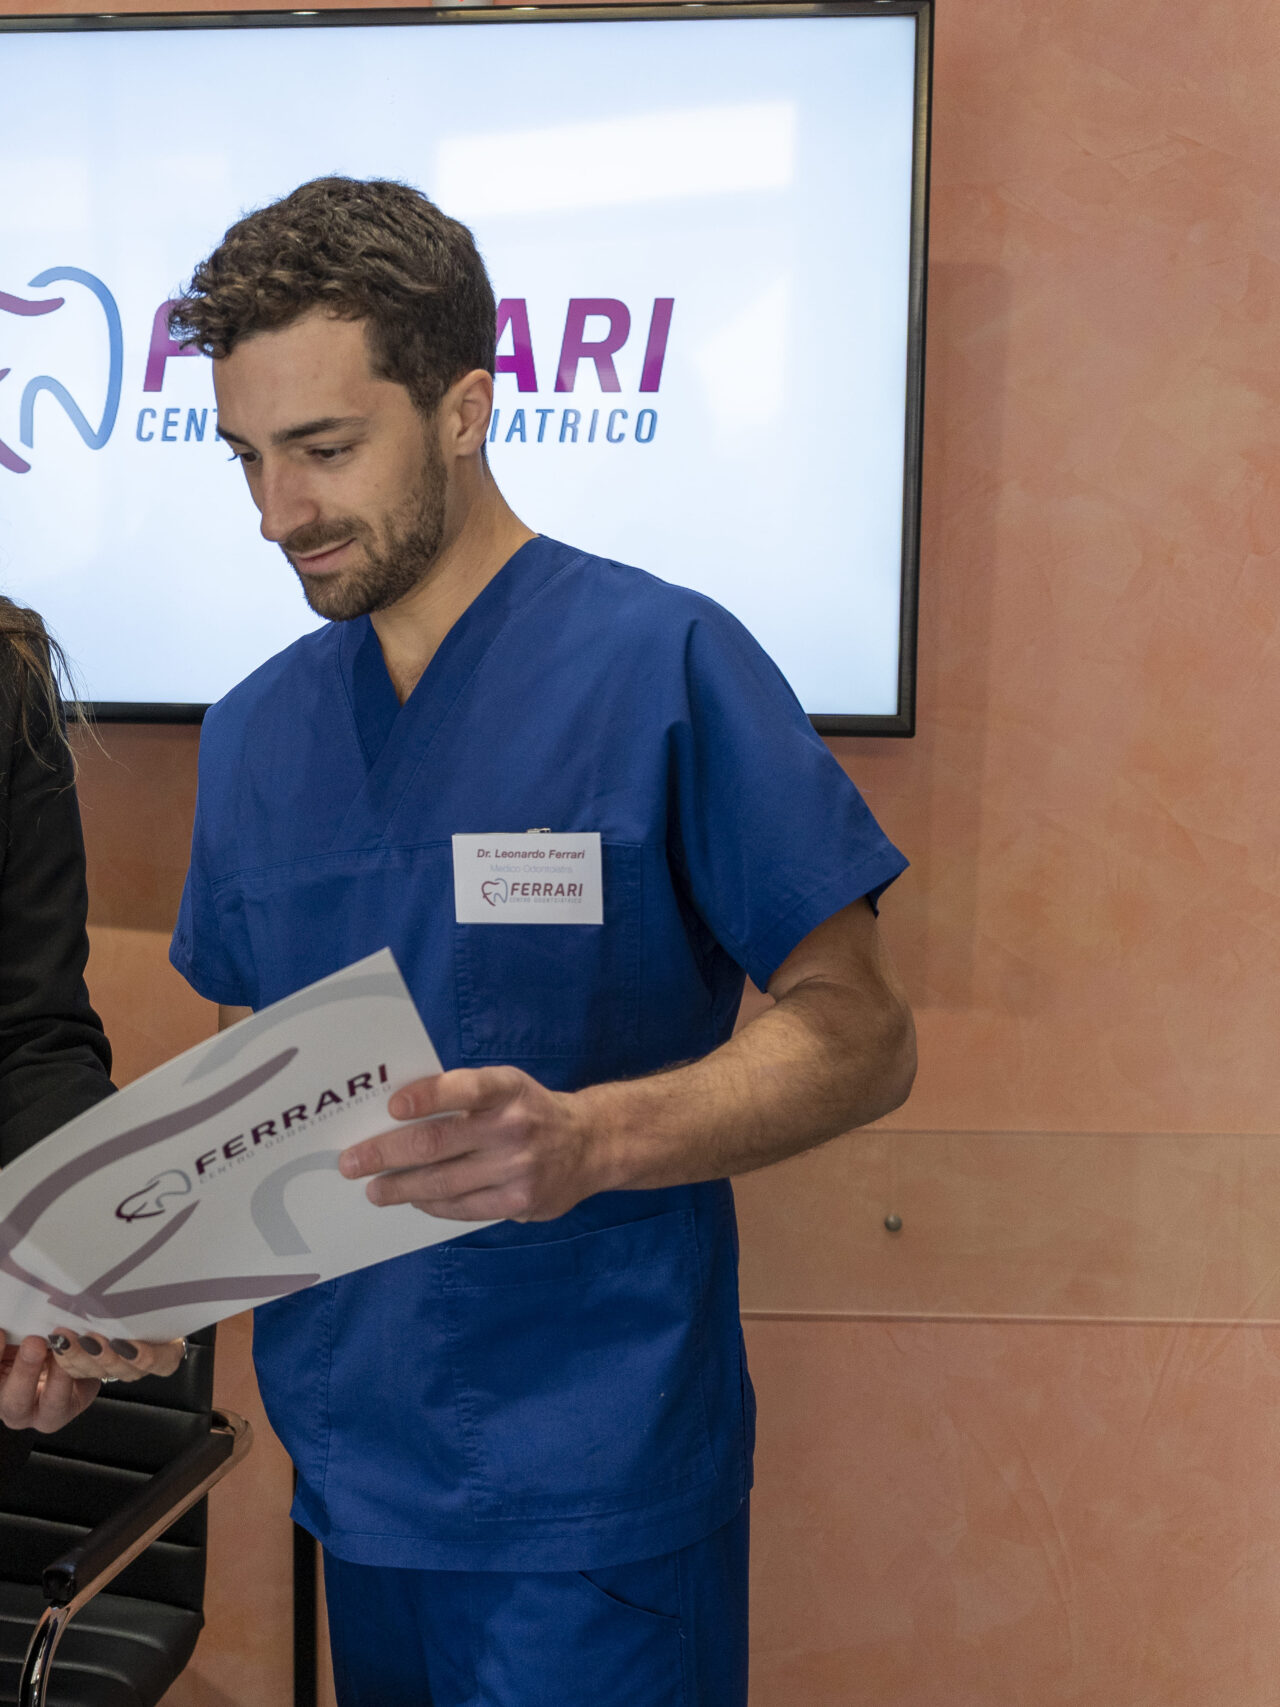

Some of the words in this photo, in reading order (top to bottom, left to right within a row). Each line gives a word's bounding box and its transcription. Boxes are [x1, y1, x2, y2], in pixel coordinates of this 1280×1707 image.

[143, 298, 674, 392] FARI
[136, 408, 219, 442] CEN
[489, 409, 658, 443] IATRICO
[477, 849, 491, 858] Dr.
[495, 849, 546, 859] Leonardo
[549, 849, 585, 859] Ferrari
[510, 882, 583, 896] FERRARI
[194, 1064, 389, 1176] FERRARI
